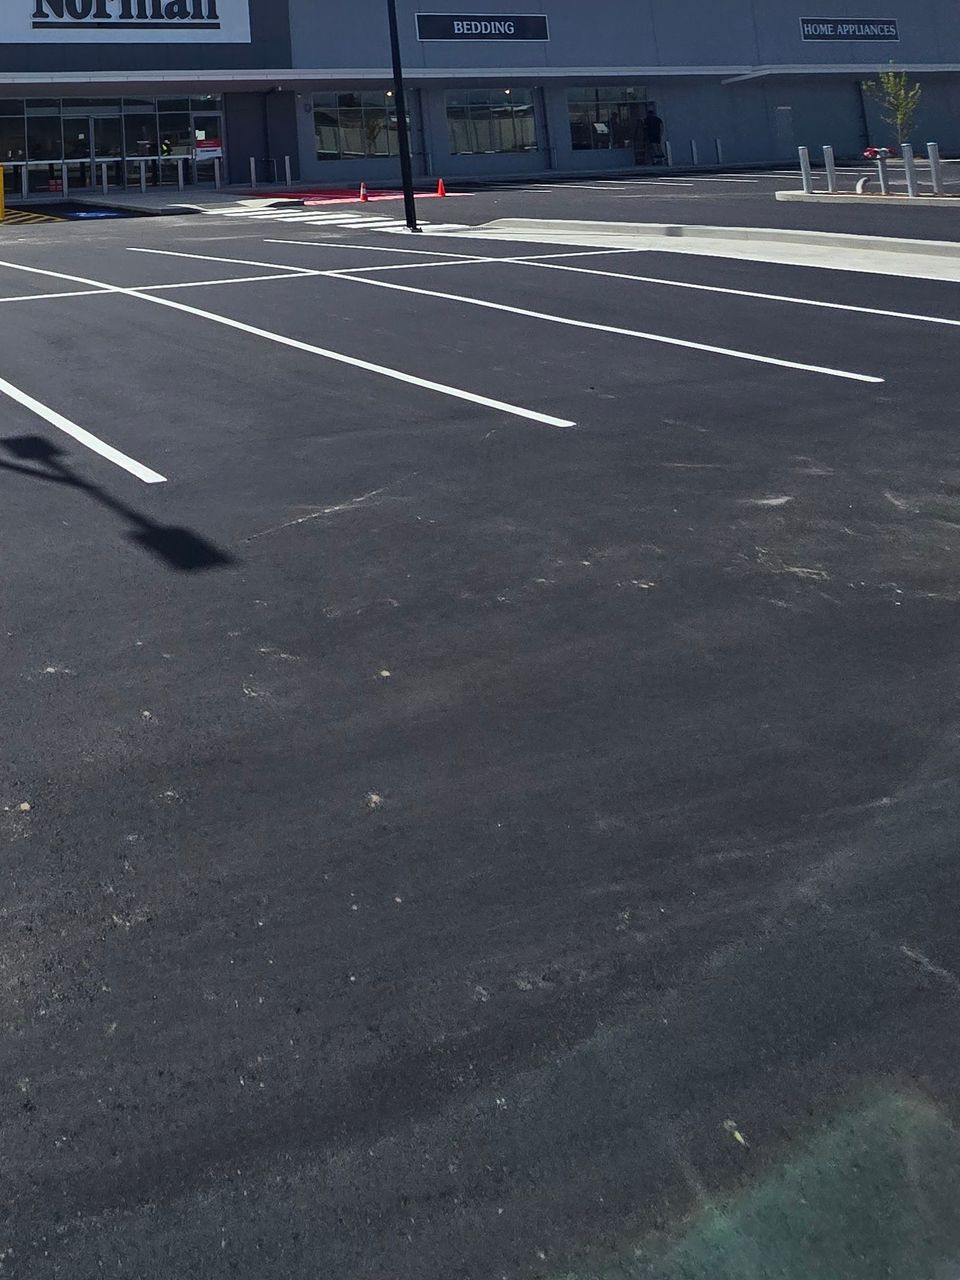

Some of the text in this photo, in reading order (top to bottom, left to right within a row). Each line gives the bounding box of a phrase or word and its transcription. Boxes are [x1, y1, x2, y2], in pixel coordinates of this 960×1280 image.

[453, 21, 515, 34] BEDDING
[803, 23, 897, 36] HOME APPLIANCES
